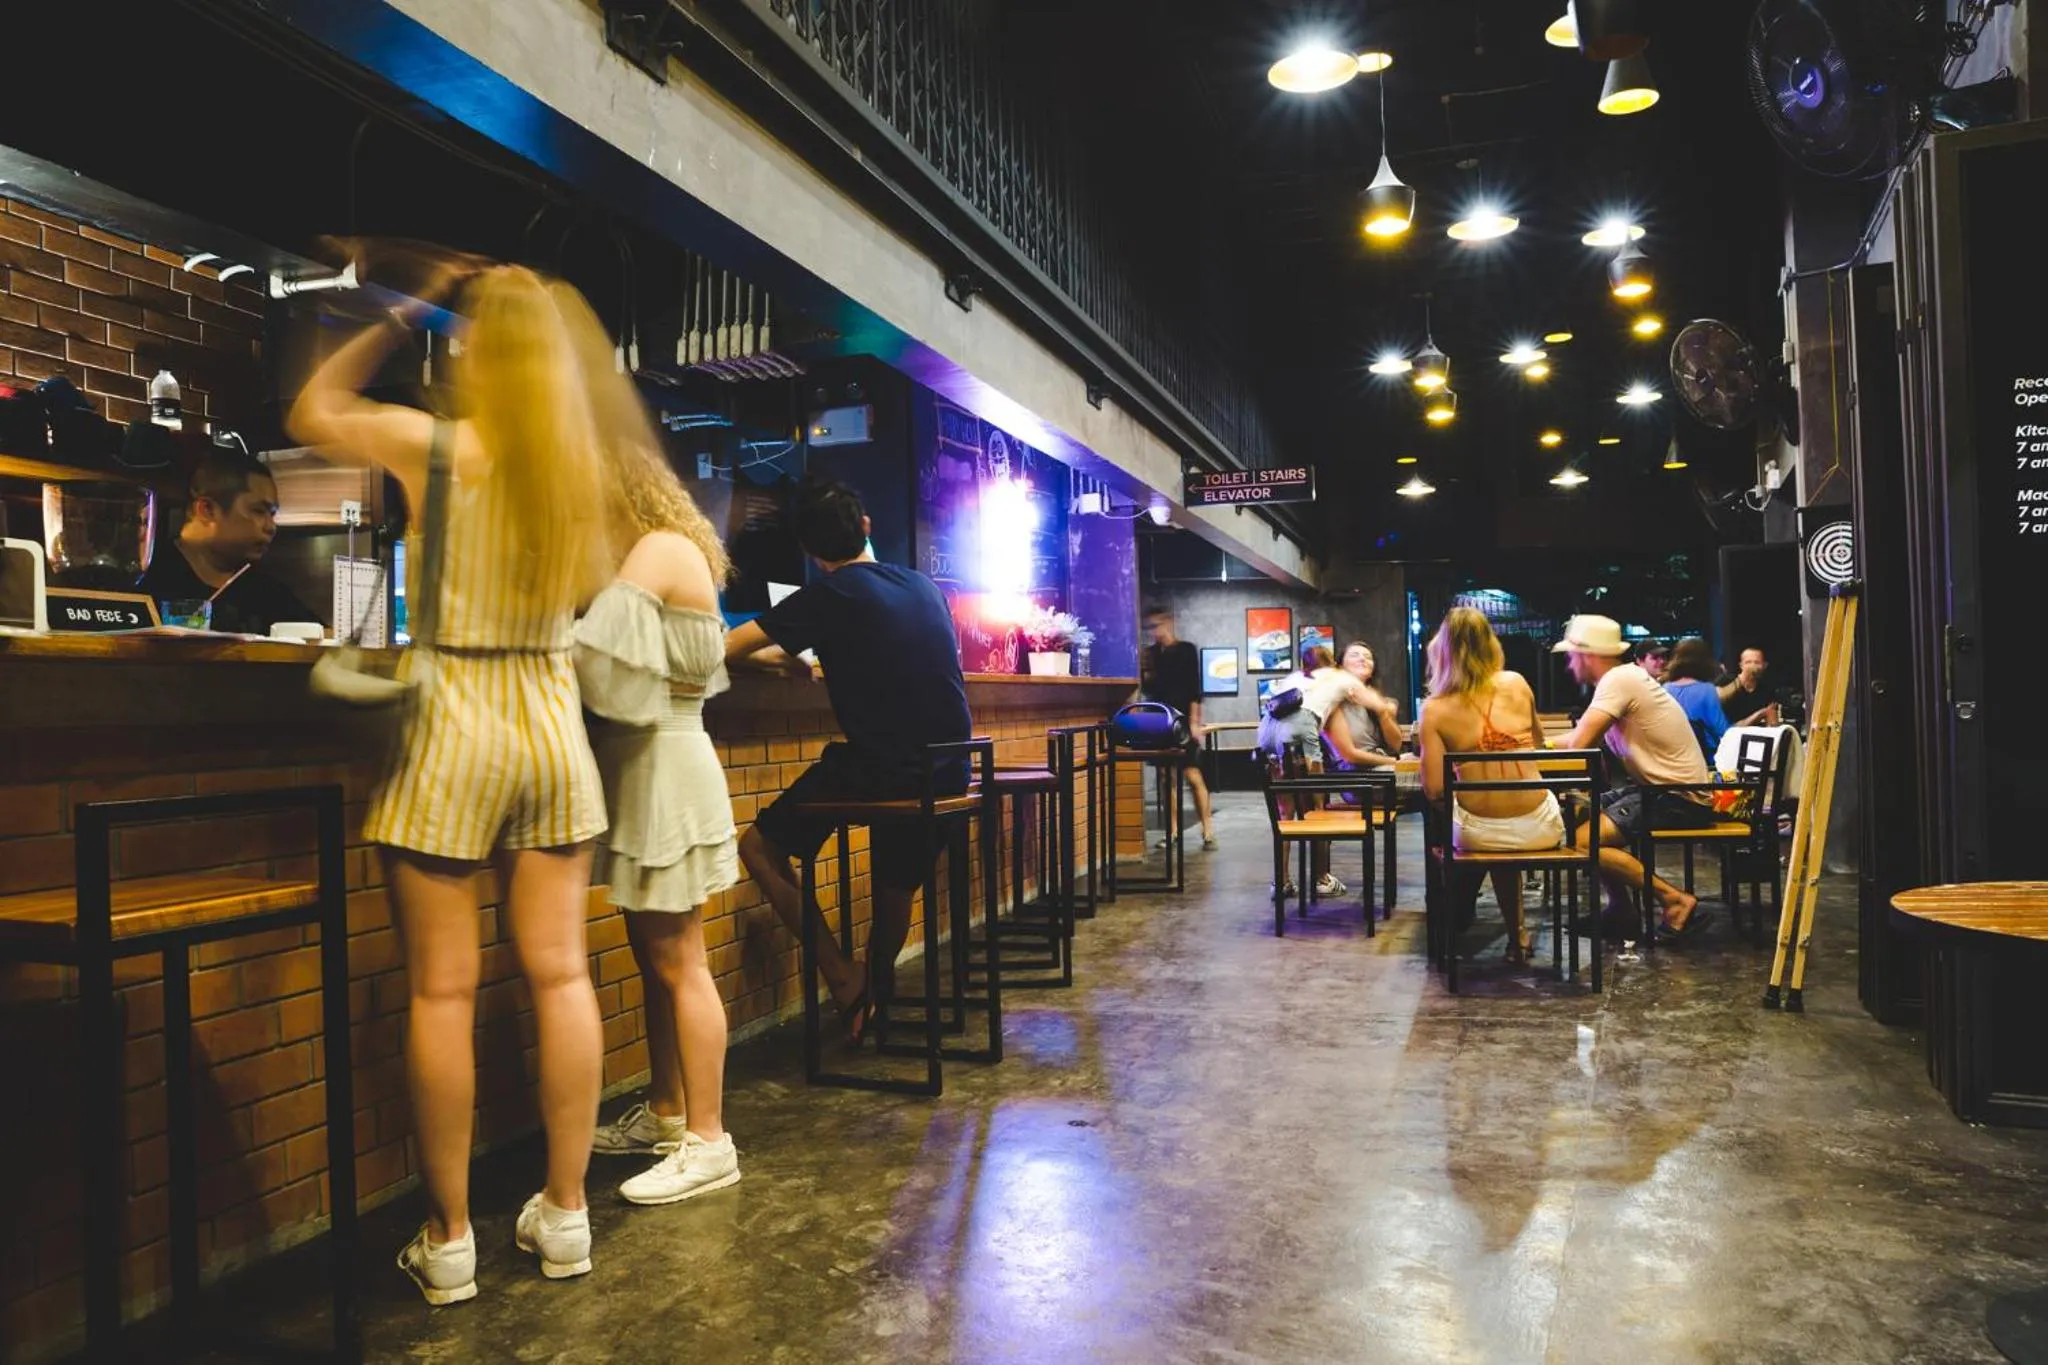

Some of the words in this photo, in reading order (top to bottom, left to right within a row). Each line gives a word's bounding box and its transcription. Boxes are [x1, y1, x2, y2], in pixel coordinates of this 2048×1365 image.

[2015, 425, 2048, 437] Kitc
[2016, 441, 2027, 453] 7
[2017, 457, 2028, 470] 7
[1204, 472, 1248, 485] TOILET
[1260, 468, 1306, 482] STAIRS
[1204, 487, 1271, 502] ELEVATOR
[2019, 506, 2029, 517] 7
[2019, 522, 2030, 534] 7
[66, 608, 91, 621] BAD
